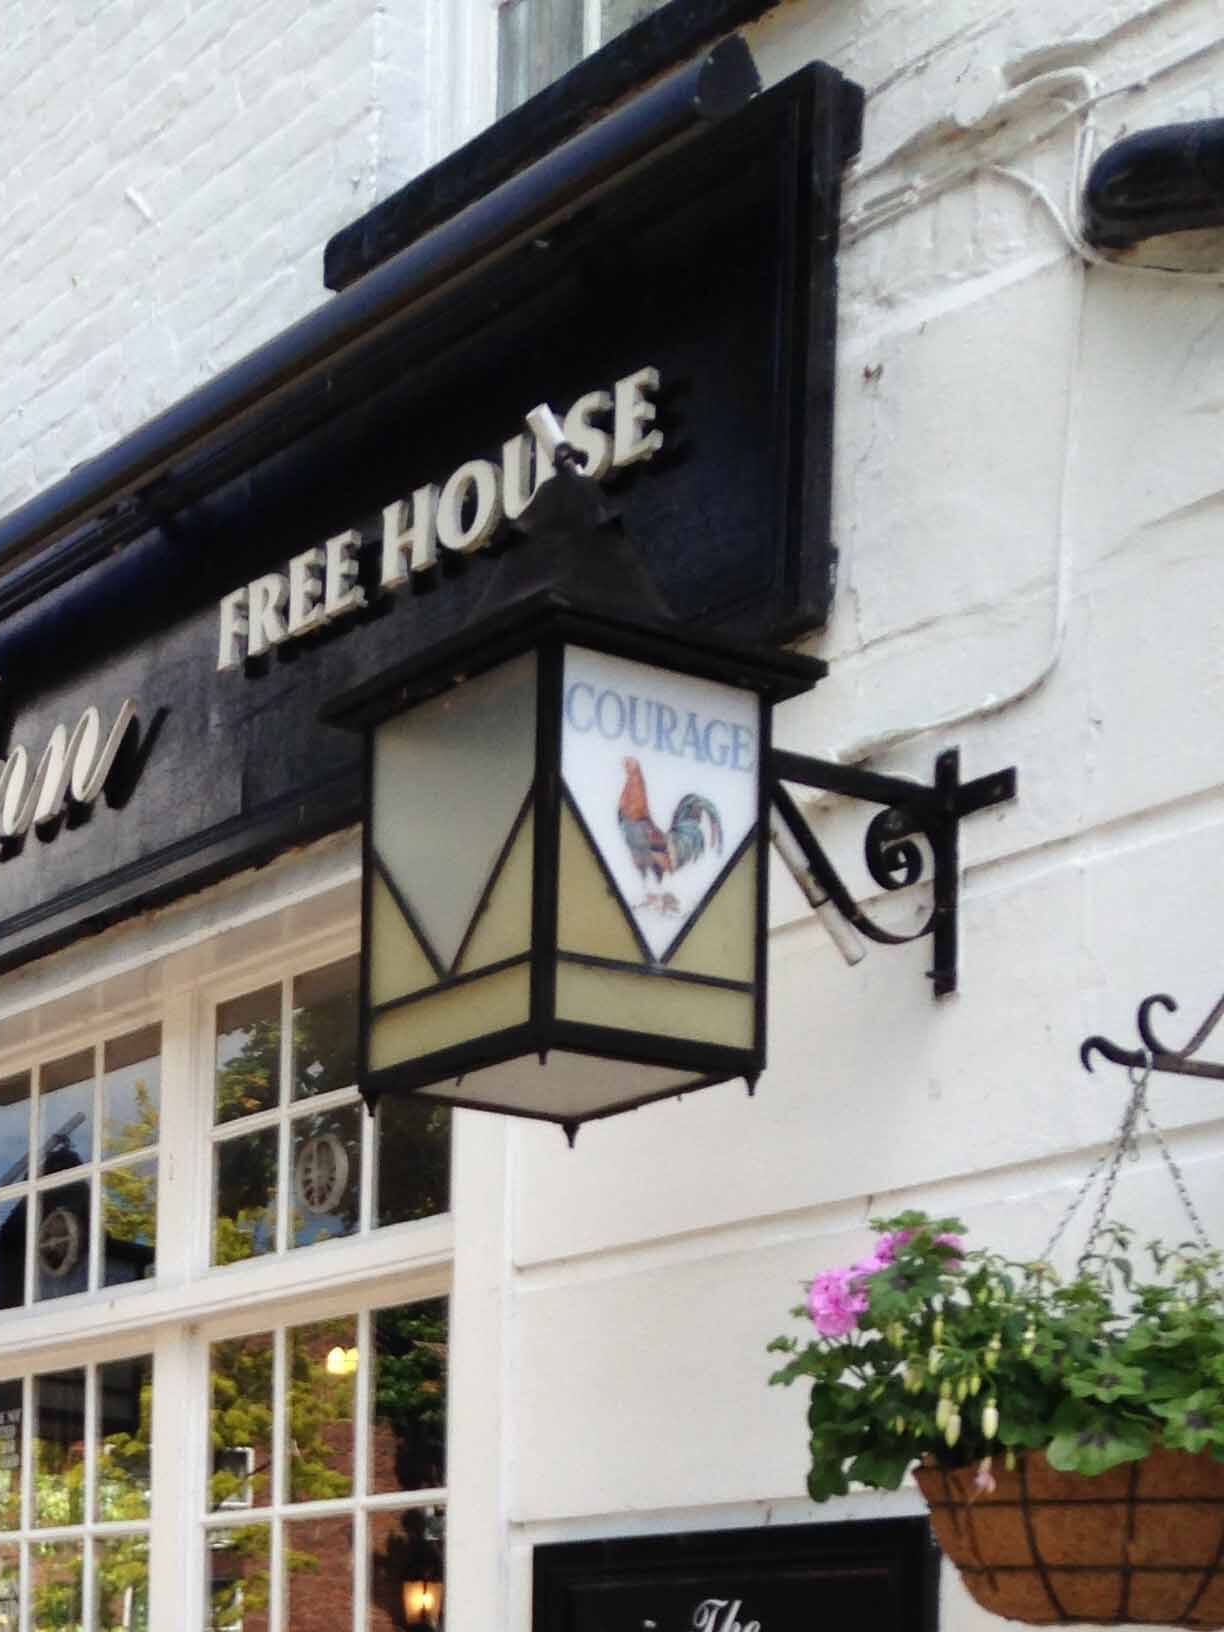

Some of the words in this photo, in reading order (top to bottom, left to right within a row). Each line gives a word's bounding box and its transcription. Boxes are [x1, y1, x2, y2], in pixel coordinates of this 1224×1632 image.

[217, 529, 368, 672] FREE
[380, 366, 664, 590] HOUSE
[565, 681, 757, 772] COURAGE
